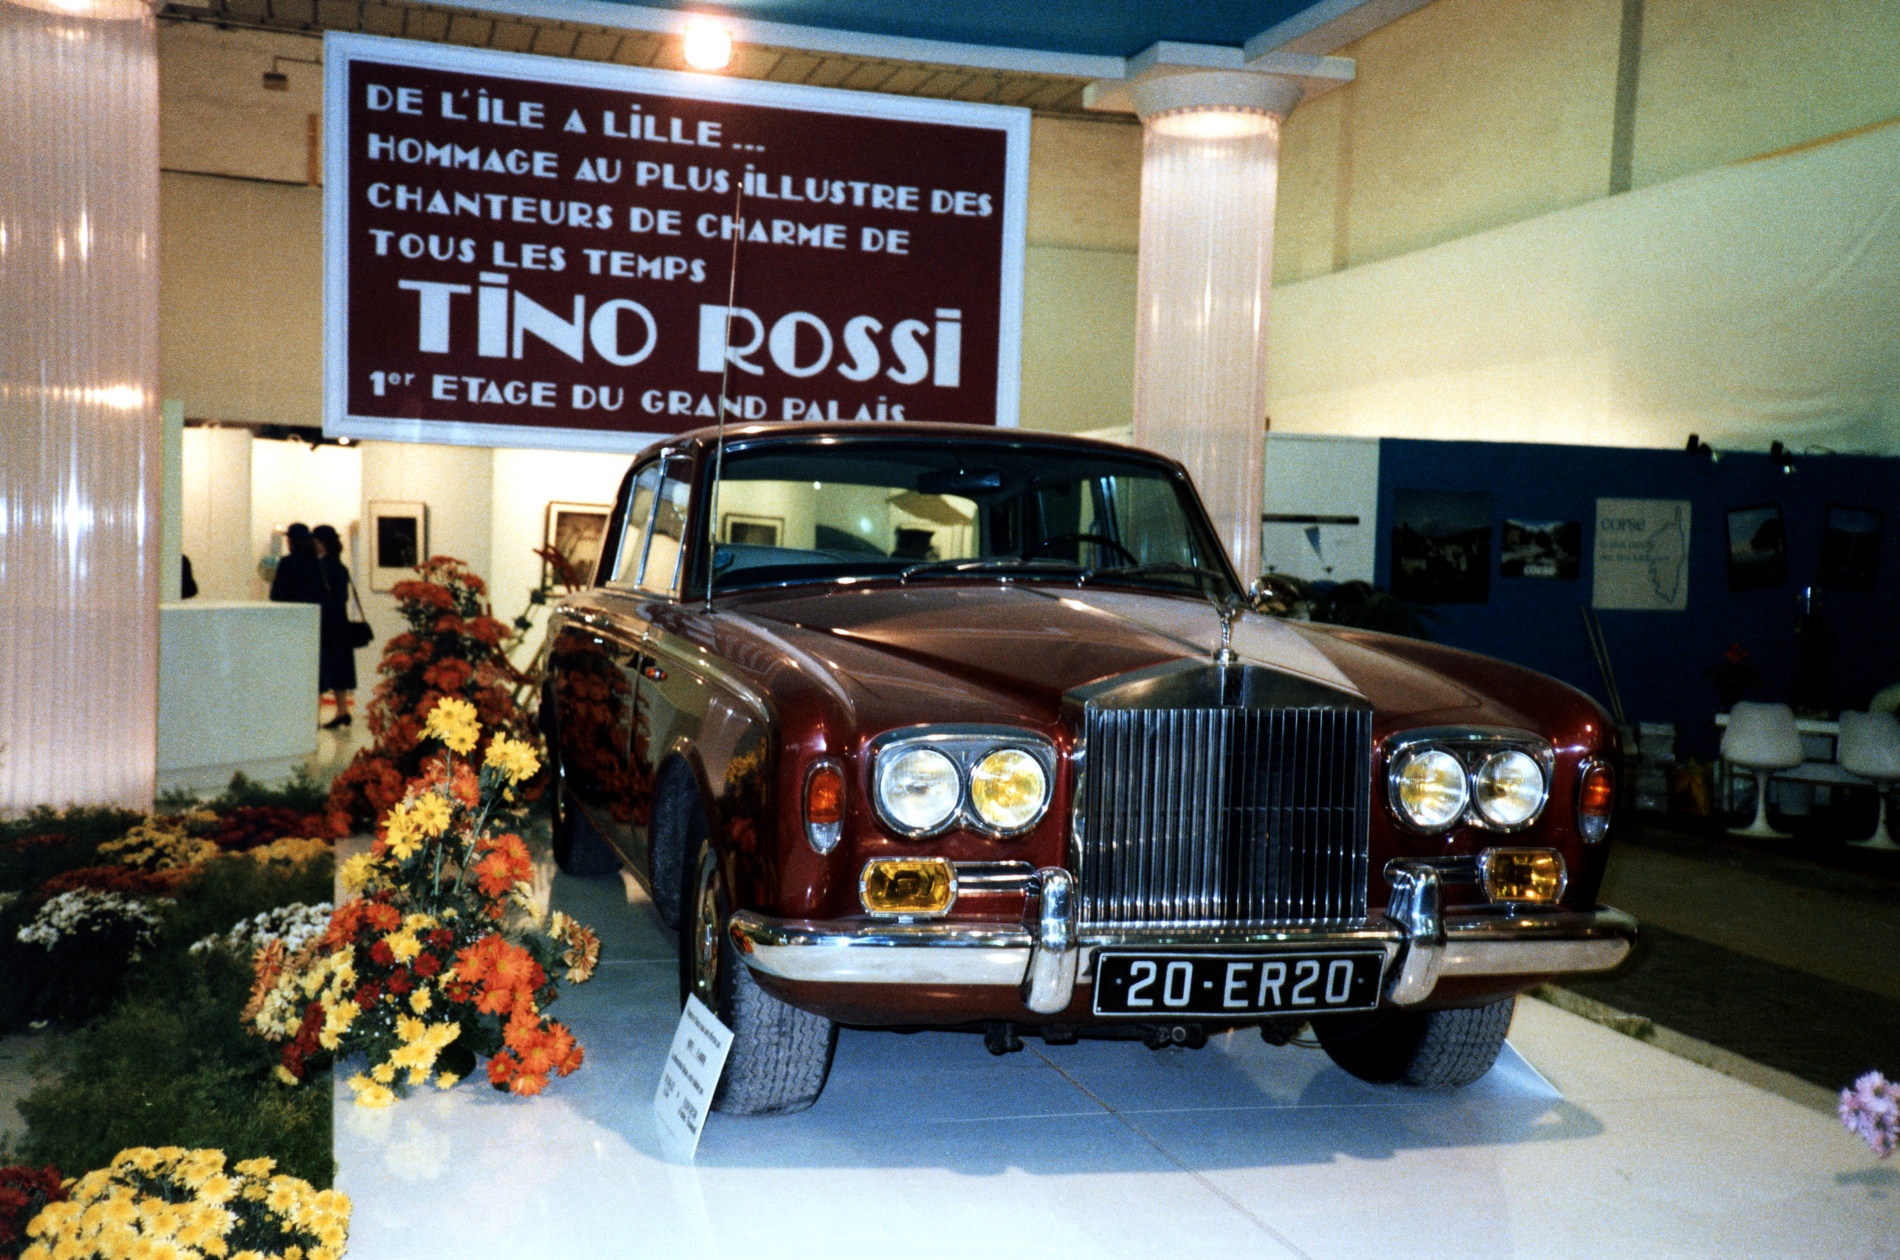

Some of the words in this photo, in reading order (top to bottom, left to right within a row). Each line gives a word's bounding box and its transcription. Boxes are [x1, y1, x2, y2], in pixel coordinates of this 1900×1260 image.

[367, 84, 422, 115] DE
[563, 108, 586, 133] A
[368, 134, 557, 178] HOMMAGE
[574, 157, 621, 183] AU
[636, 161, 729, 193] PLUS
[931, 189, 992, 216] DES
[367, 182, 612, 229] CHANTEURS
[629, 207, 680, 235] DE
[696, 213, 846, 248] CHARME
[861, 227, 909, 254] DE
[369, 230, 475, 263] TOUS
[493, 241, 566, 271] LES
[583, 249, 706, 282] TEMPS
[432, 374, 556, 407] ETAGE
[572, 384, 624, 410] DU
[641, 390, 767, 419] GRAND
